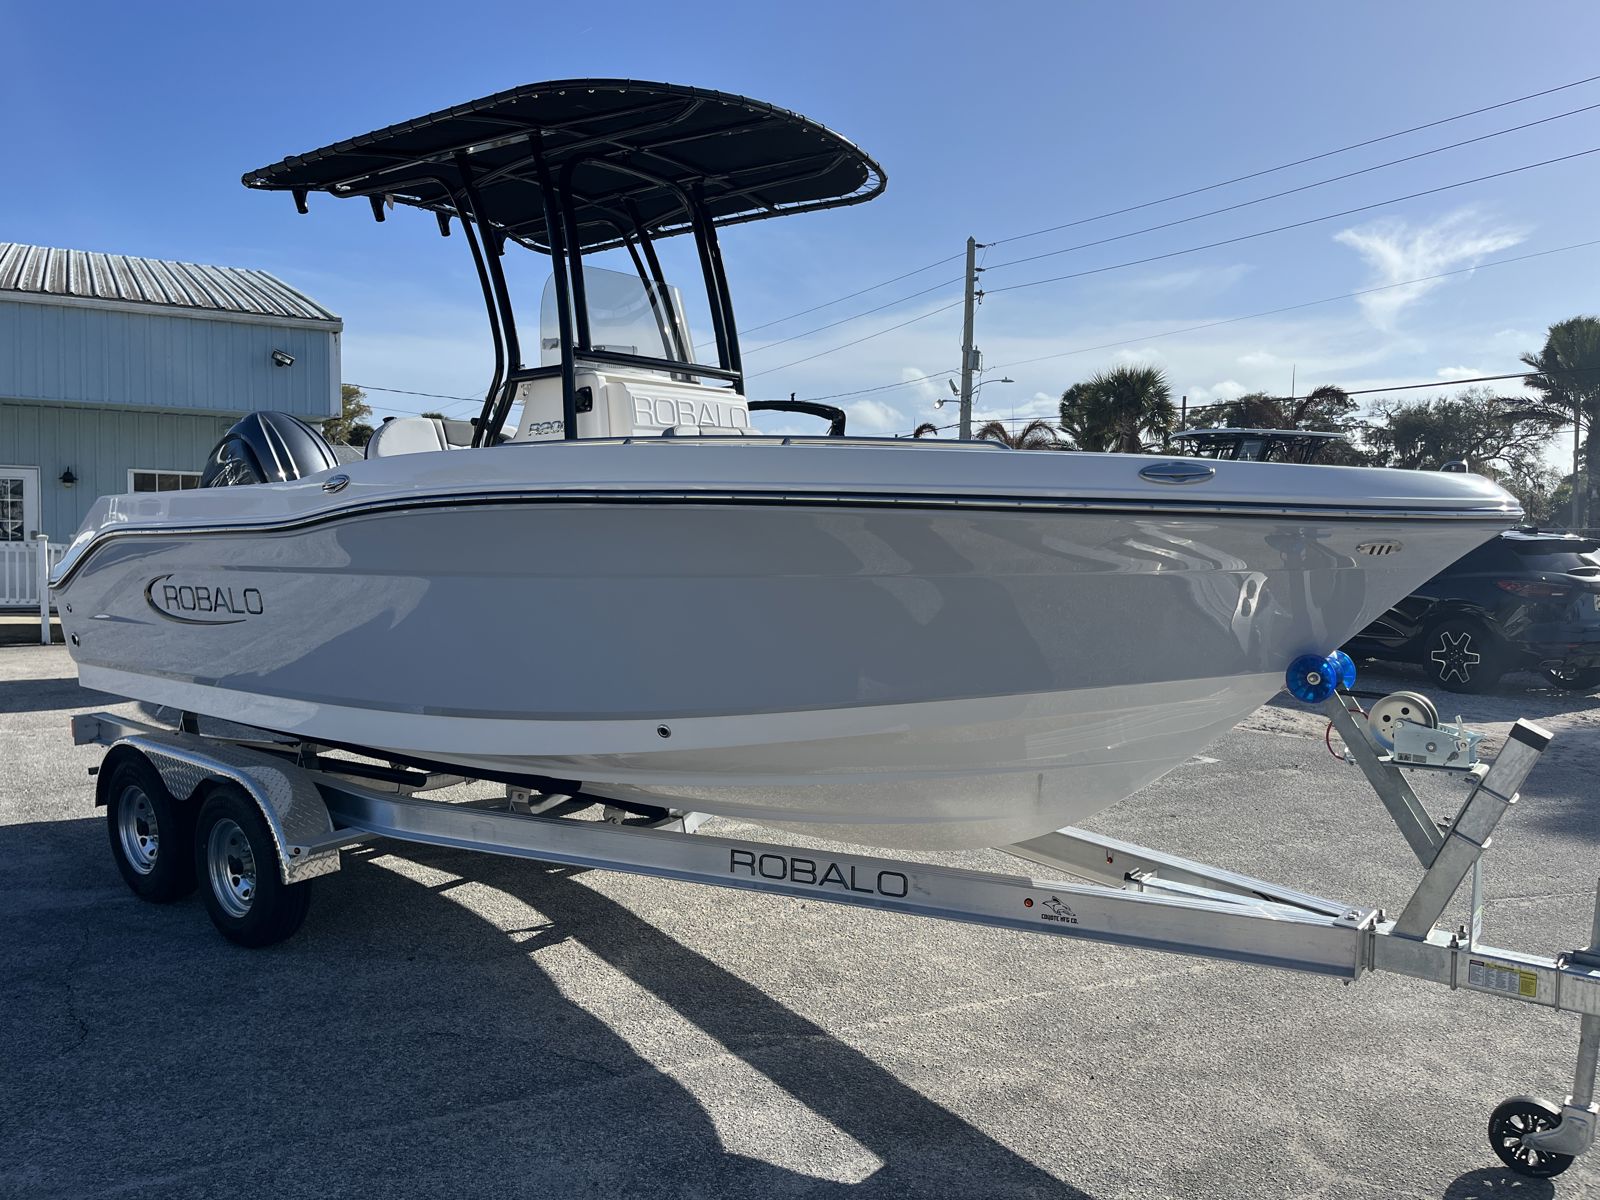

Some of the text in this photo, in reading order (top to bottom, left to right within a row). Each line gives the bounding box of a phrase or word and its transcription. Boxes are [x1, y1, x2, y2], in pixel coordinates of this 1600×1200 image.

[631, 395, 749, 428] ROBALO
[528, 420, 565, 436] R20
[163, 585, 264, 615] ROBALO
[730, 849, 908, 898] ROBALO
[1041, 913, 1060, 922] COYOTE
[1060, 915, 1070, 923] MFG
